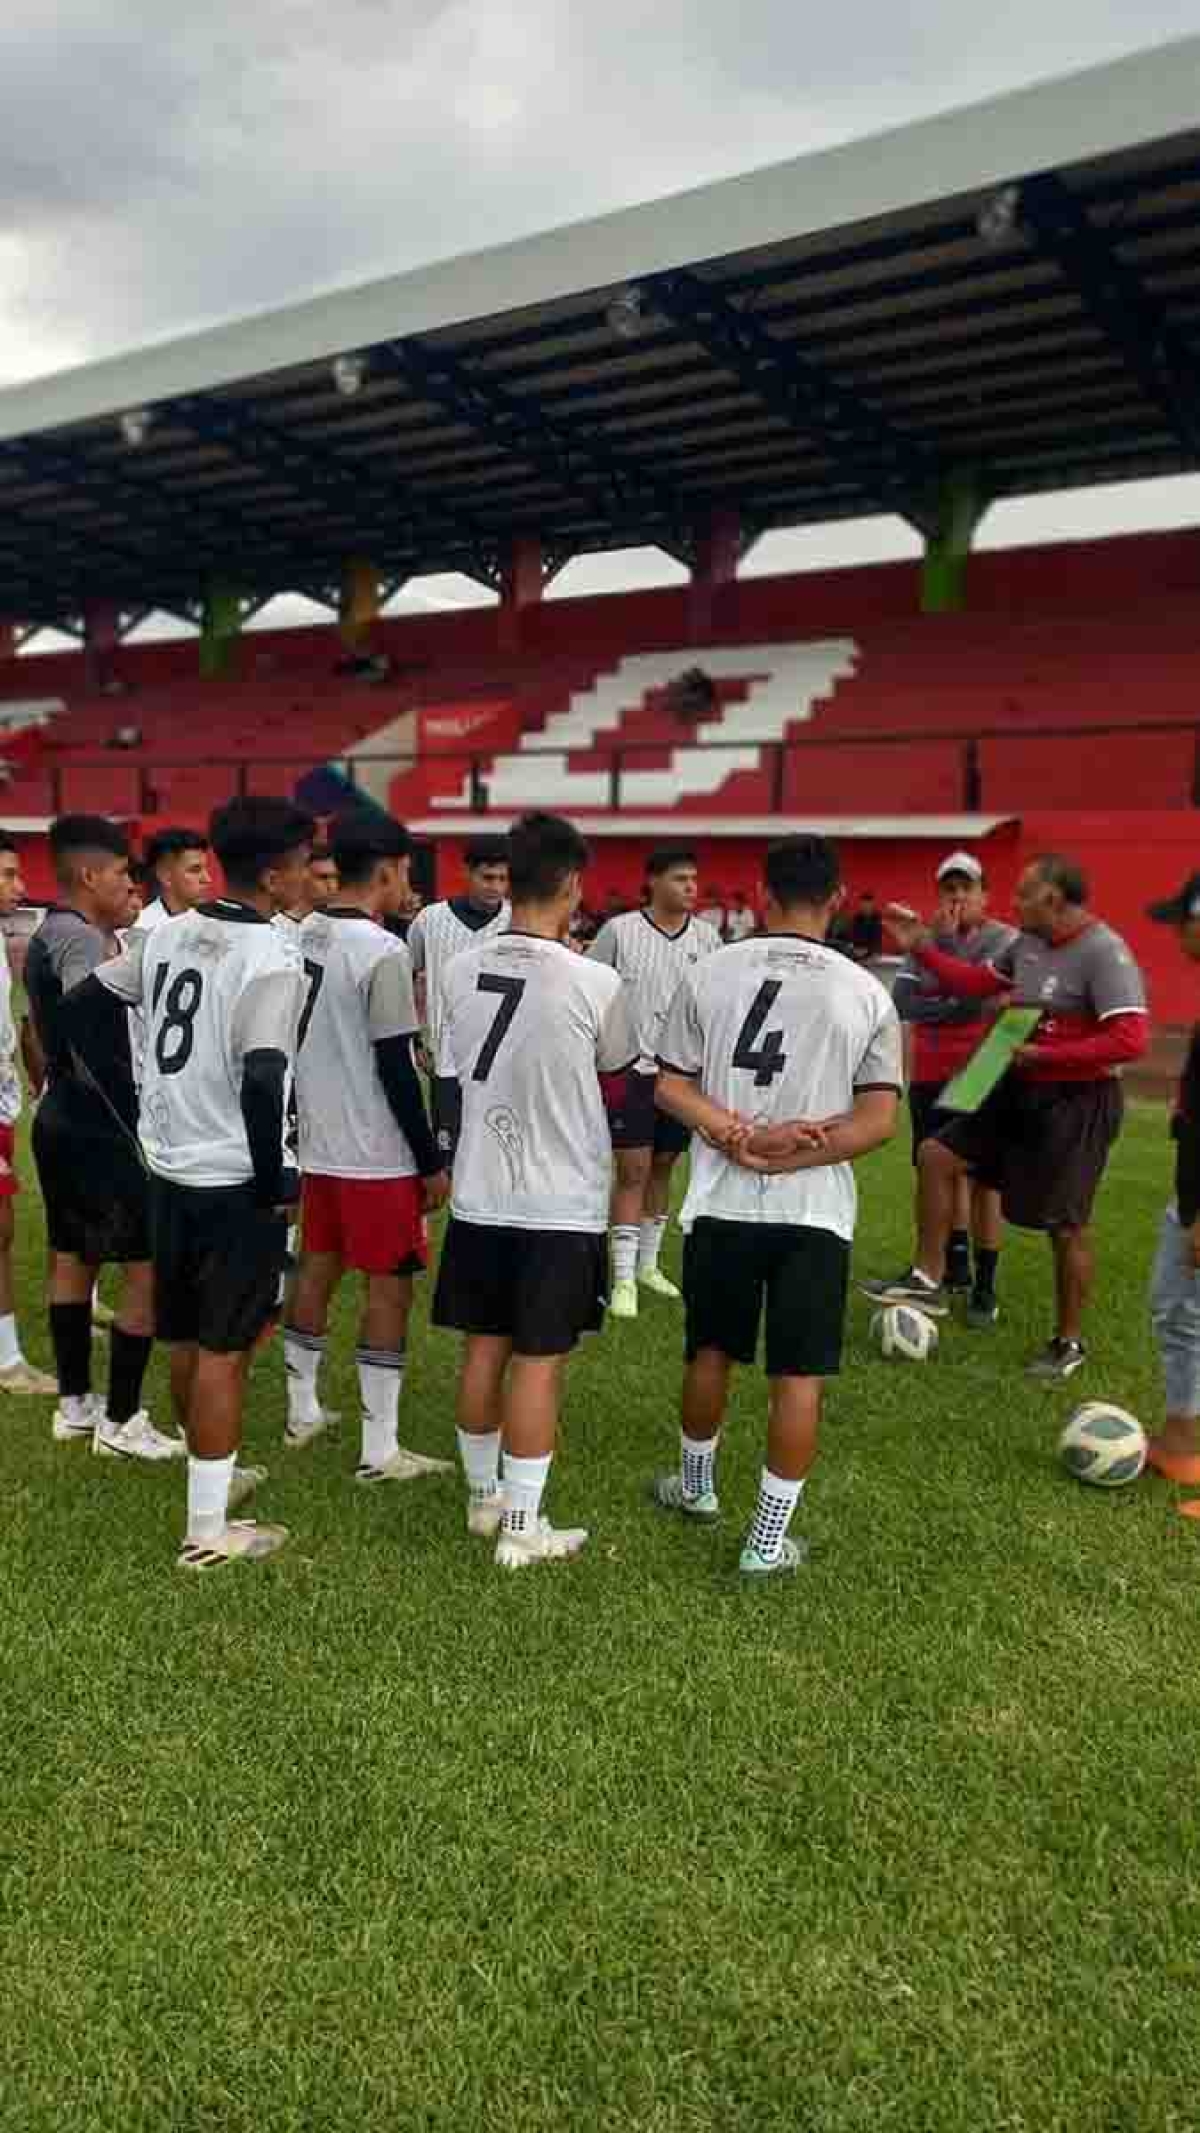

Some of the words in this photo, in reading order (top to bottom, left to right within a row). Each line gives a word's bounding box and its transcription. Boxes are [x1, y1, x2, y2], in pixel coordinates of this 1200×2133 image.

[153, 962, 203, 1075] 18
[471, 972, 526, 1082] 7
[732, 980, 786, 1087] 4
